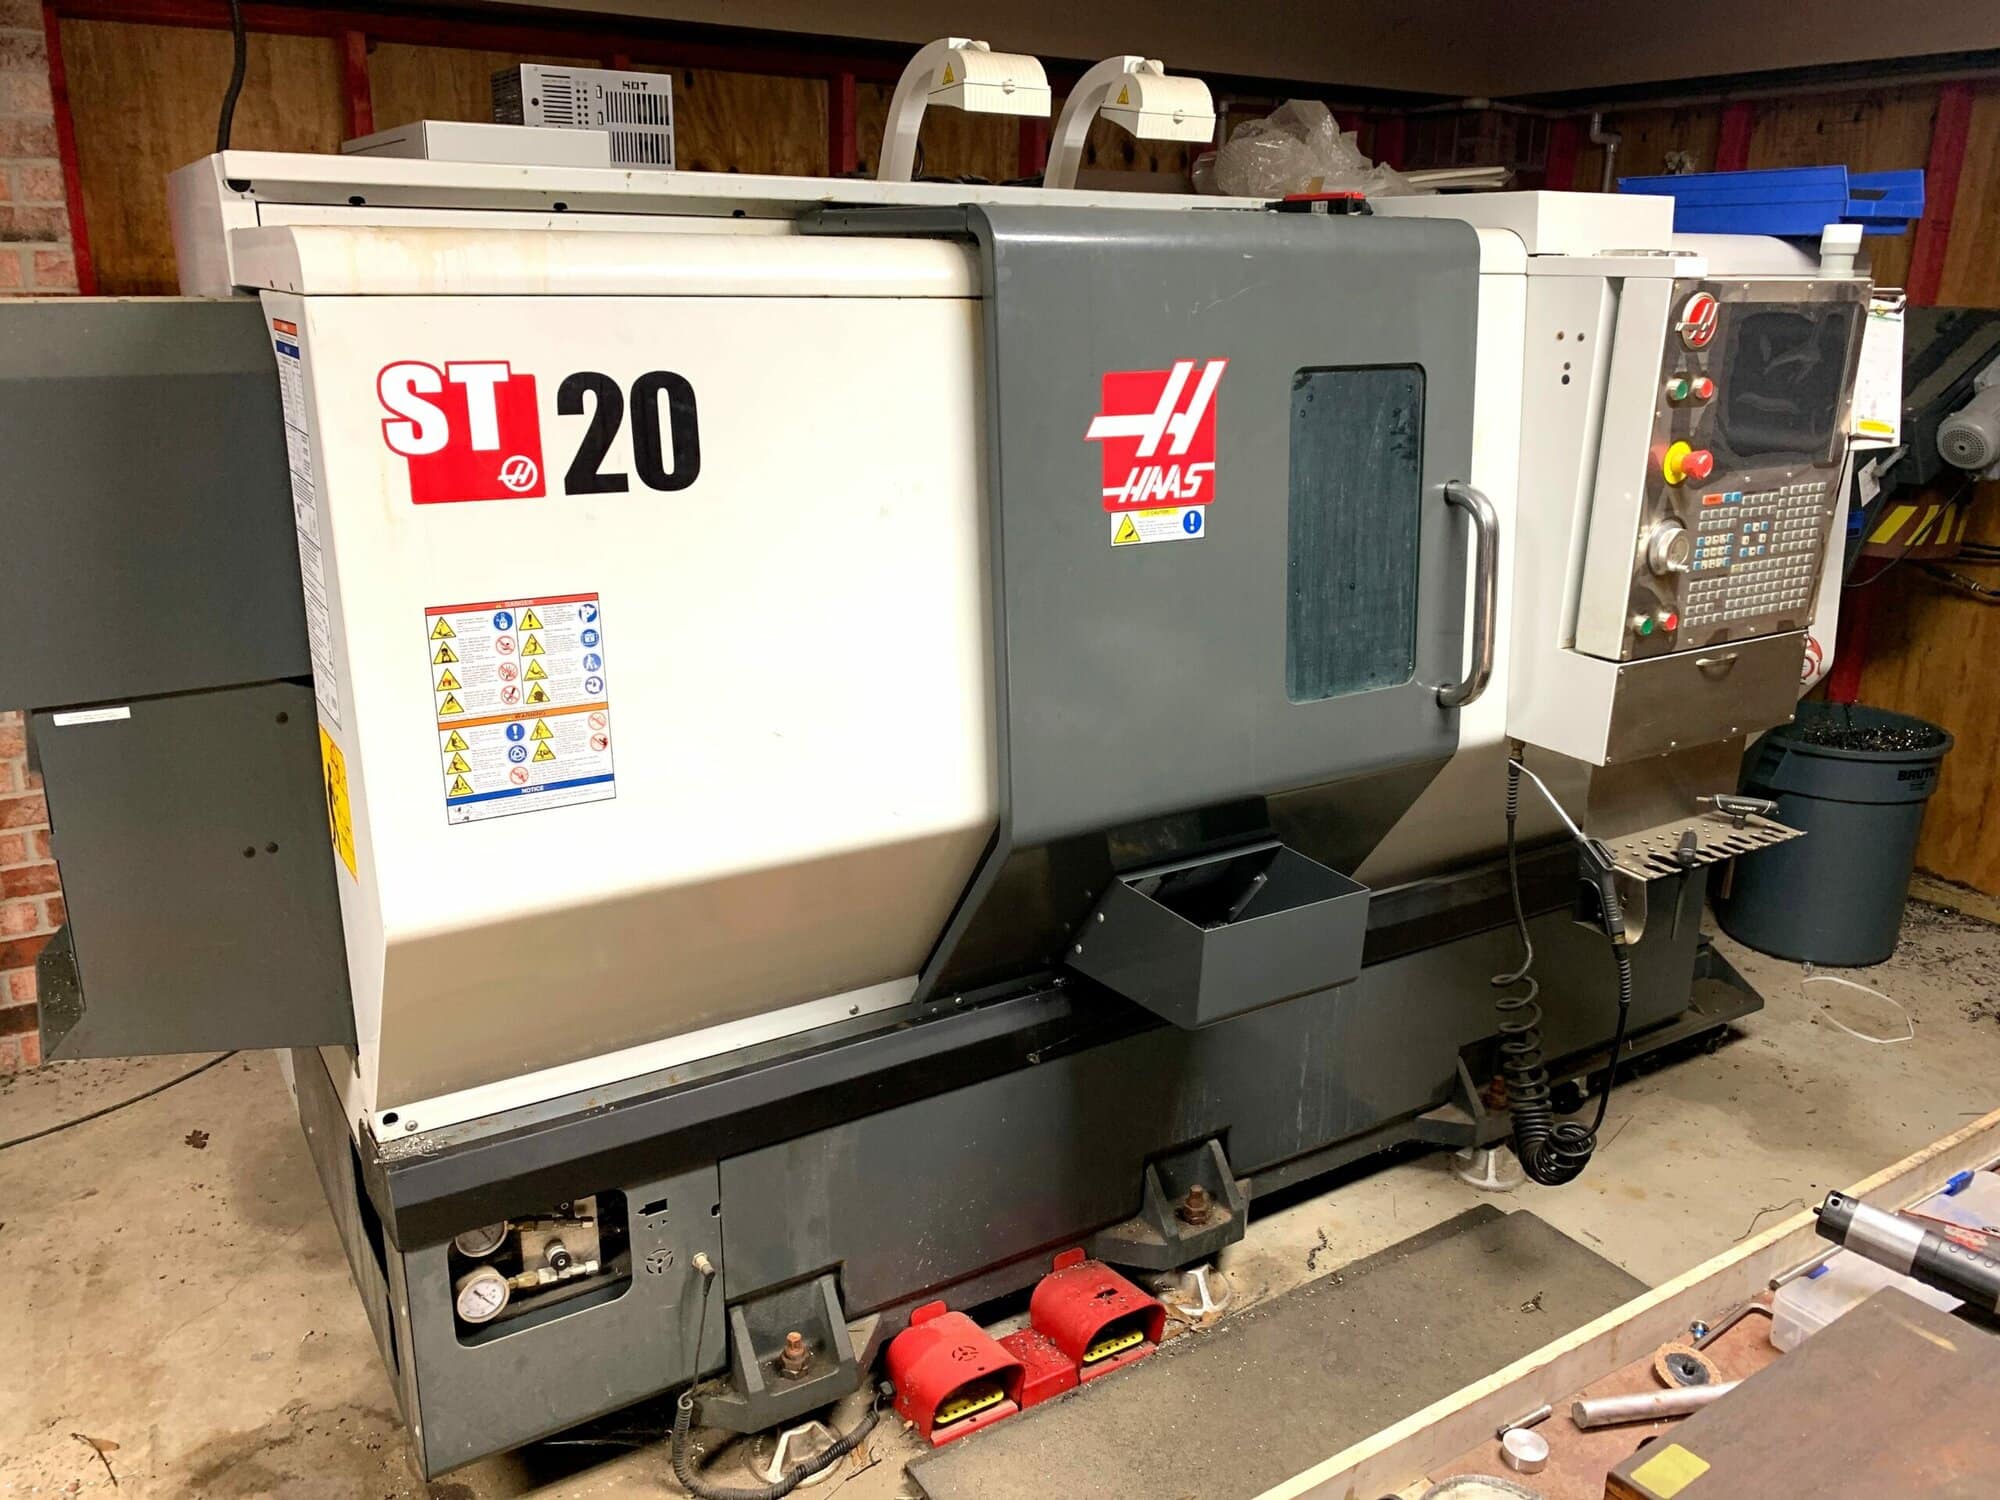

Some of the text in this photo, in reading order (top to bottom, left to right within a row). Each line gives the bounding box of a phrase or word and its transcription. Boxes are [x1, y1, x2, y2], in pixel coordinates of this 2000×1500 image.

[622, 80, 648, 91] HOT
[377, 360, 510, 456] ST
[557, 370, 701, 496] 20
[1103, 462, 1216, 504] HAAS
[521, 785, 545, 794] NOTICE
